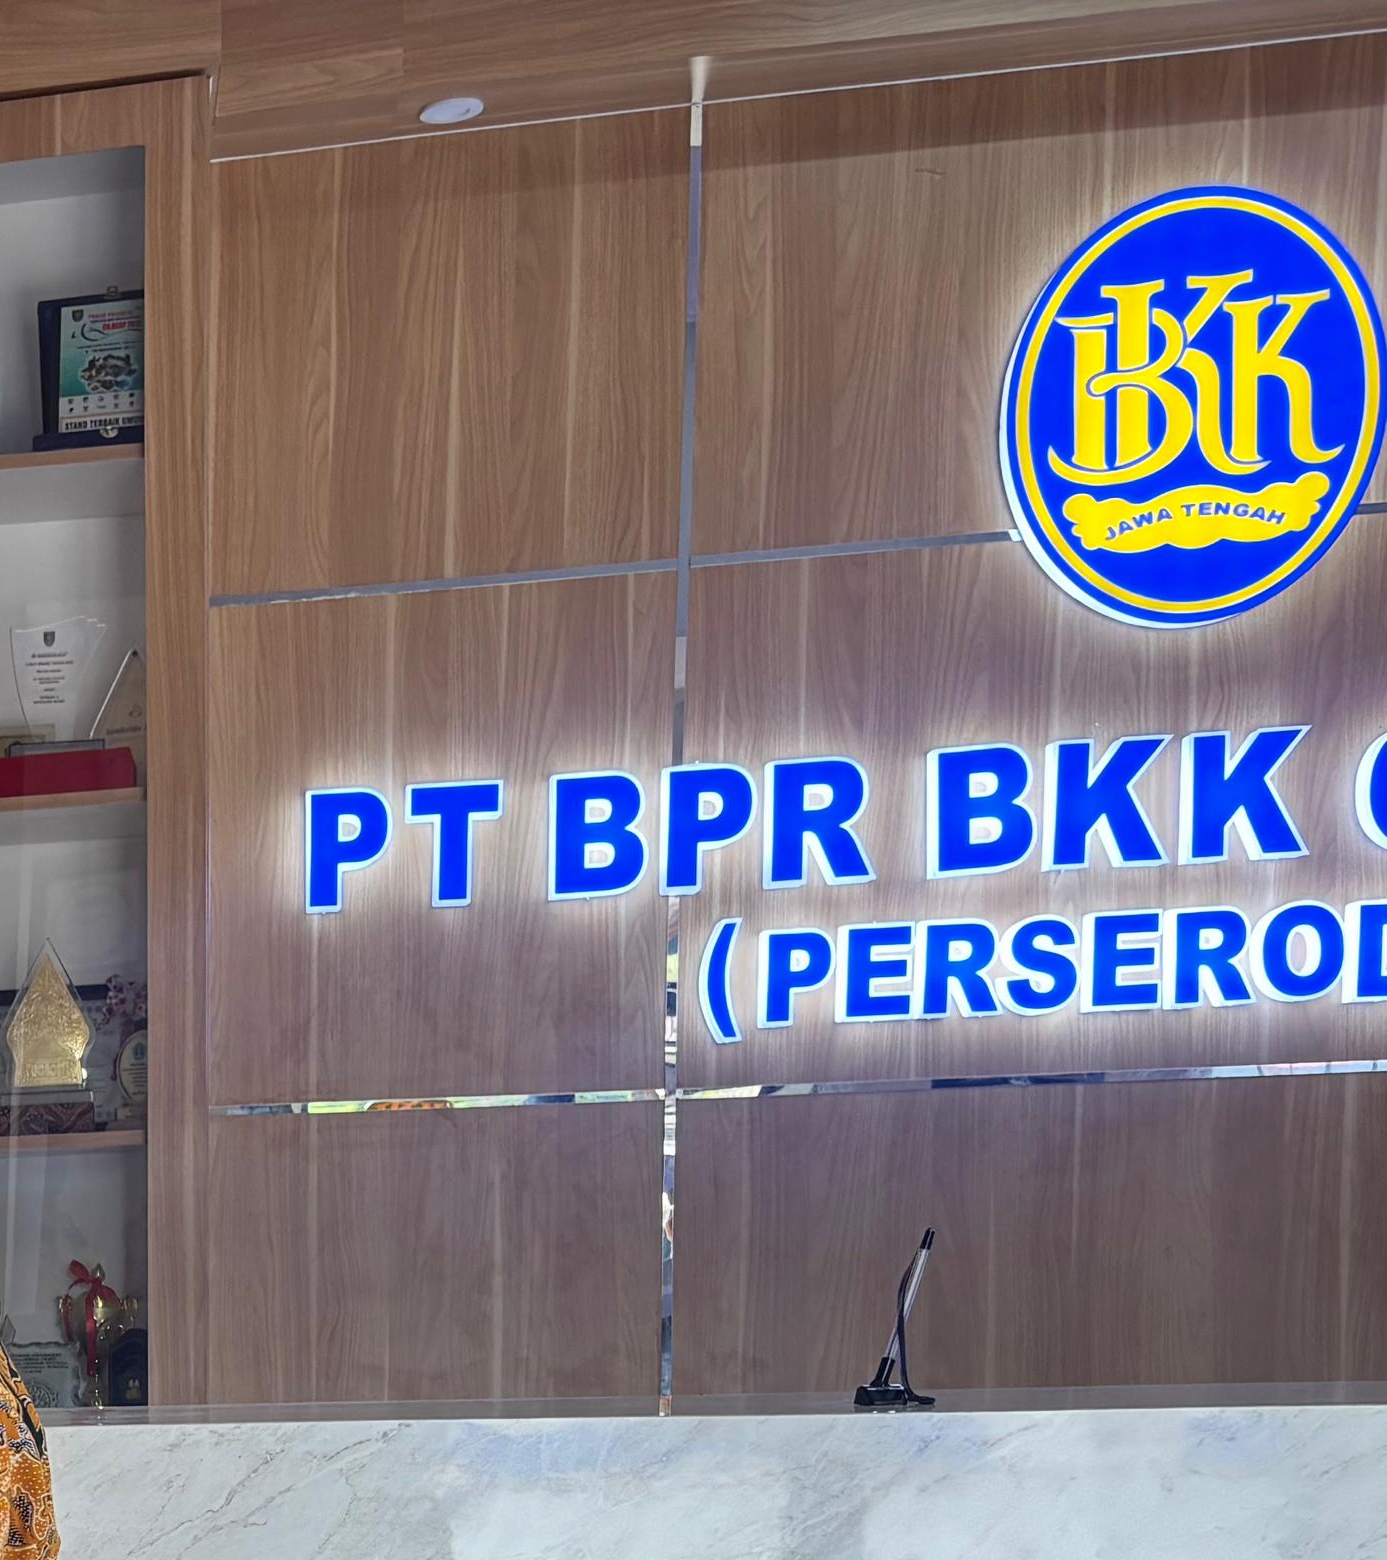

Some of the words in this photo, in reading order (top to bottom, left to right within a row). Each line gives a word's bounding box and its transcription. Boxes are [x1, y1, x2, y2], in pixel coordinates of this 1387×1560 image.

[1103, 504, 1173, 544] JAWA
[1180, 499, 1286, 526] TENGAH
[305, 778, 505, 915] PT
[547, 755, 875, 902] BPR
[927, 724, 1312, 881] BKK
